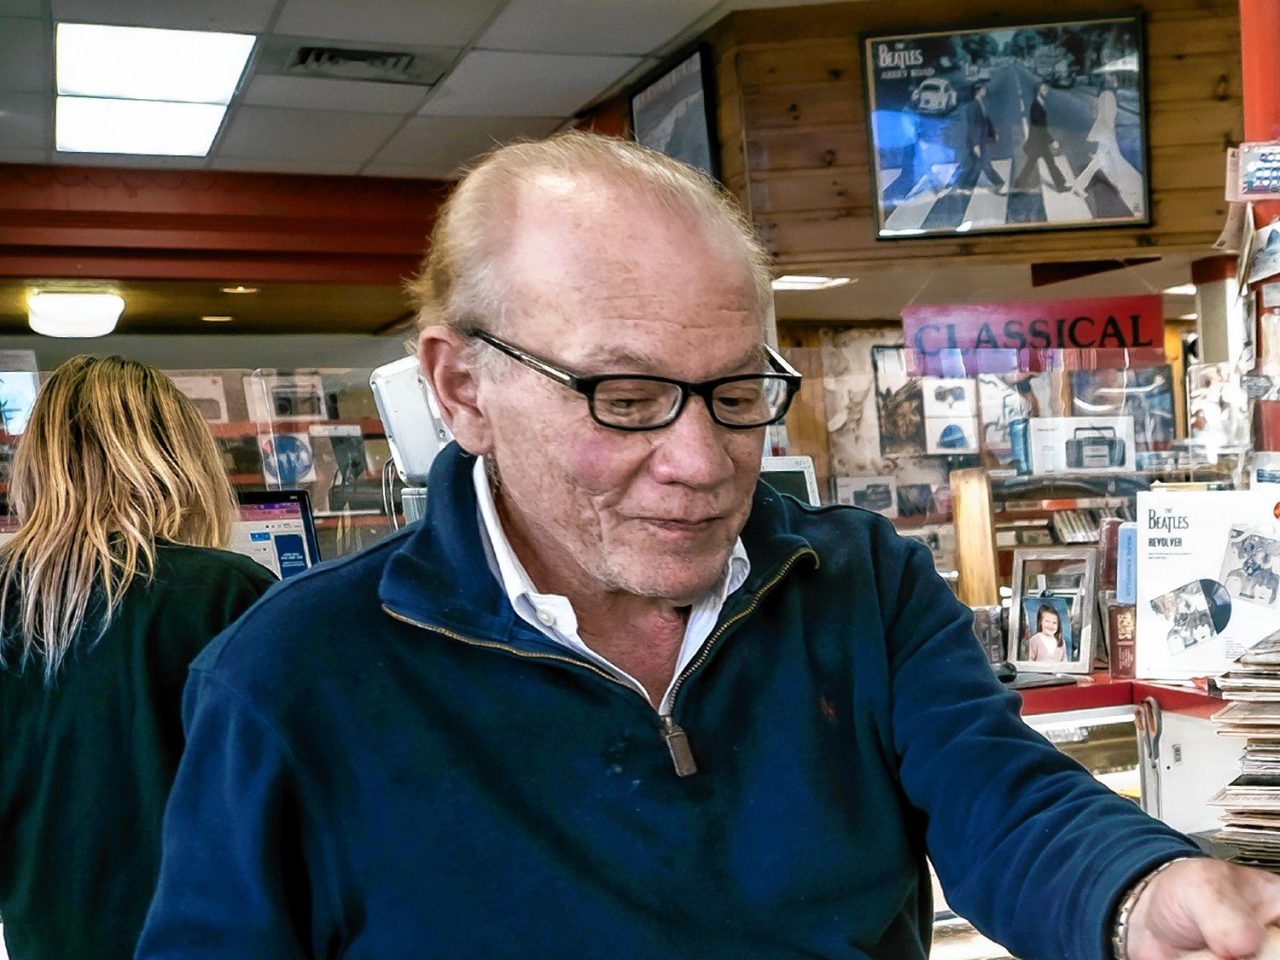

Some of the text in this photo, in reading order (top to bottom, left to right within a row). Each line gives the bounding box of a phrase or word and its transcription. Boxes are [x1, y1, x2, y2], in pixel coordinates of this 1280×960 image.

[879, 44, 923, 68] BEATLES
[914, 315, 1153, 356] CLASSICAL
[1148, 508, 1190, 533] BEATLES
[1148, 537, 1183, 547] REVOLVER
